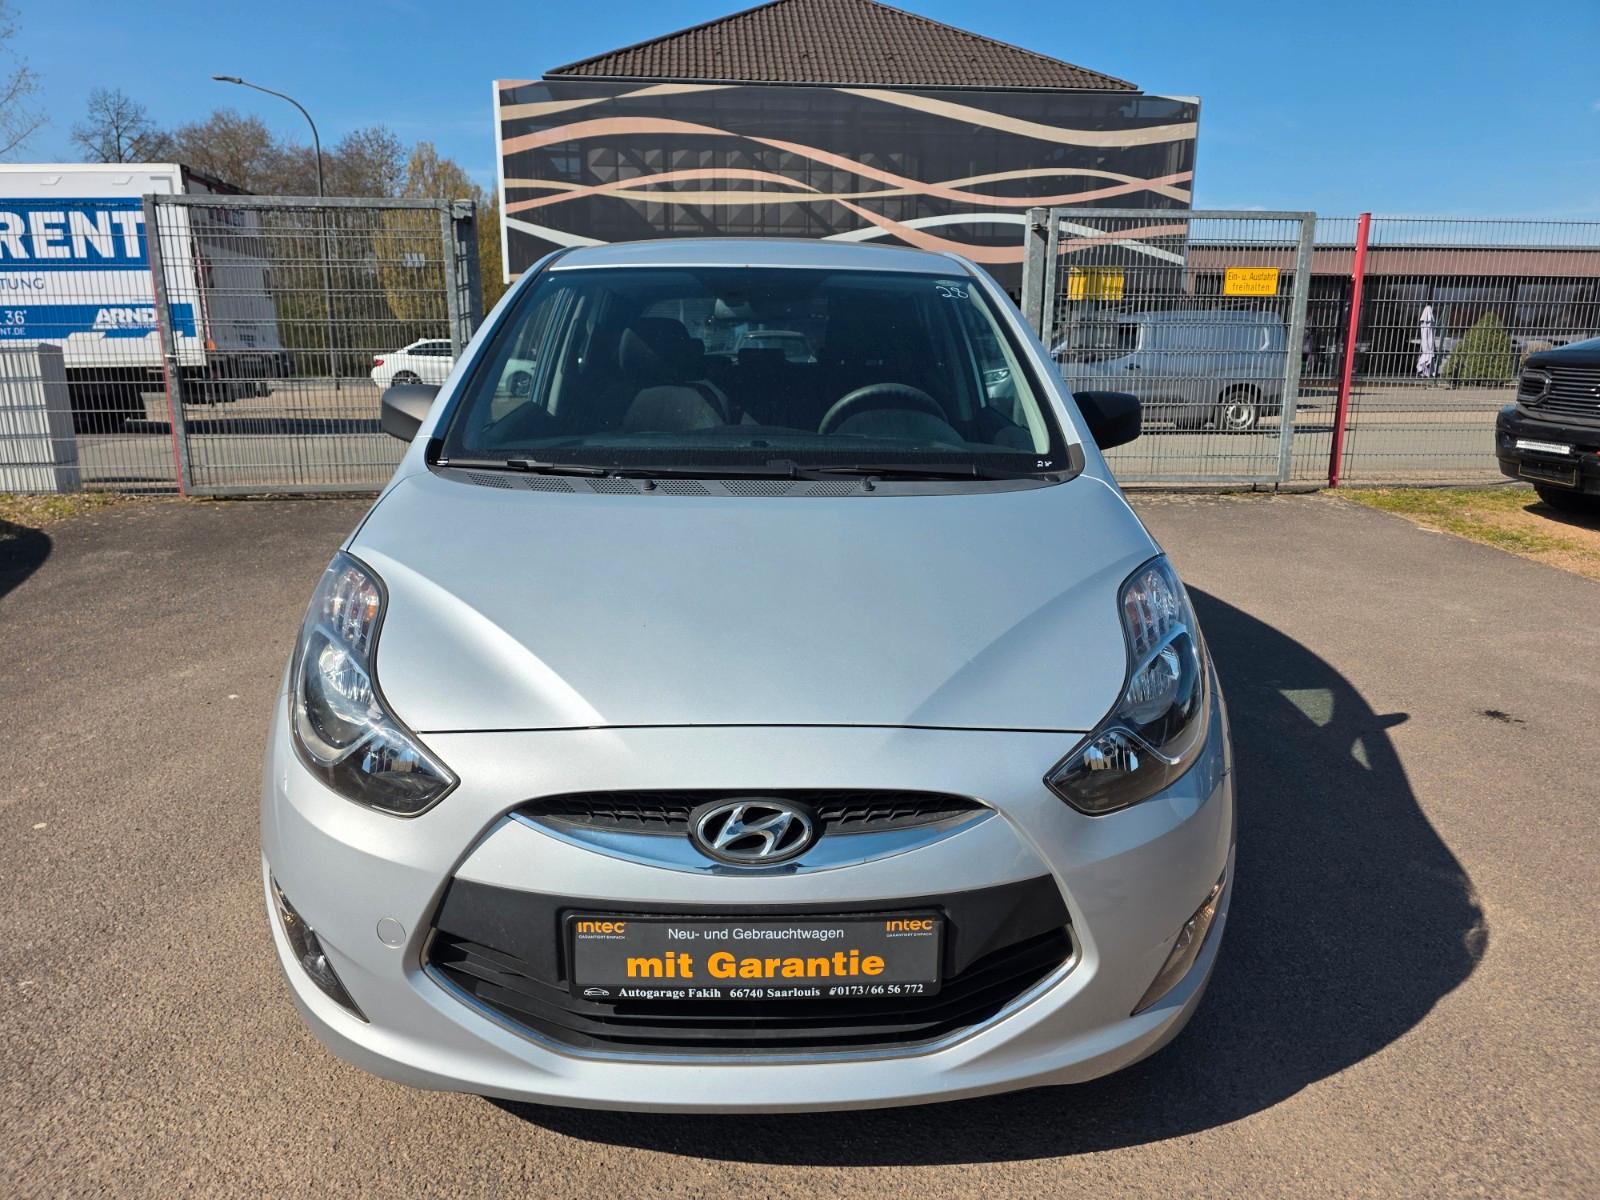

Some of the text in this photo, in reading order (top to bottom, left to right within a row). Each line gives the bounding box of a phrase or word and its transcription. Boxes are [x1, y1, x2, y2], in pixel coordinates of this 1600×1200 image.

[0, 211, 146, 259] RENT
[0, 277, 44, 290] TUNG
[1232, 282, 1271, 292] freihalten
[577, 921, 625, 934] intec
[886, 919, 933, 931] intec
[668, 927, 844, 941] Neu- und Gebrauchtwagen
[626, 949, 885, 979] mit Garantie
[618, 987, 685, 999] Autogarage
[688, 987, 721, 998] Fakih
[729, 987, 763, 998] 66740
[767, 986, 821, 998] Saarlouis
[887, 984, 901, 994] 56
[904, 983, 924, 993] 772
